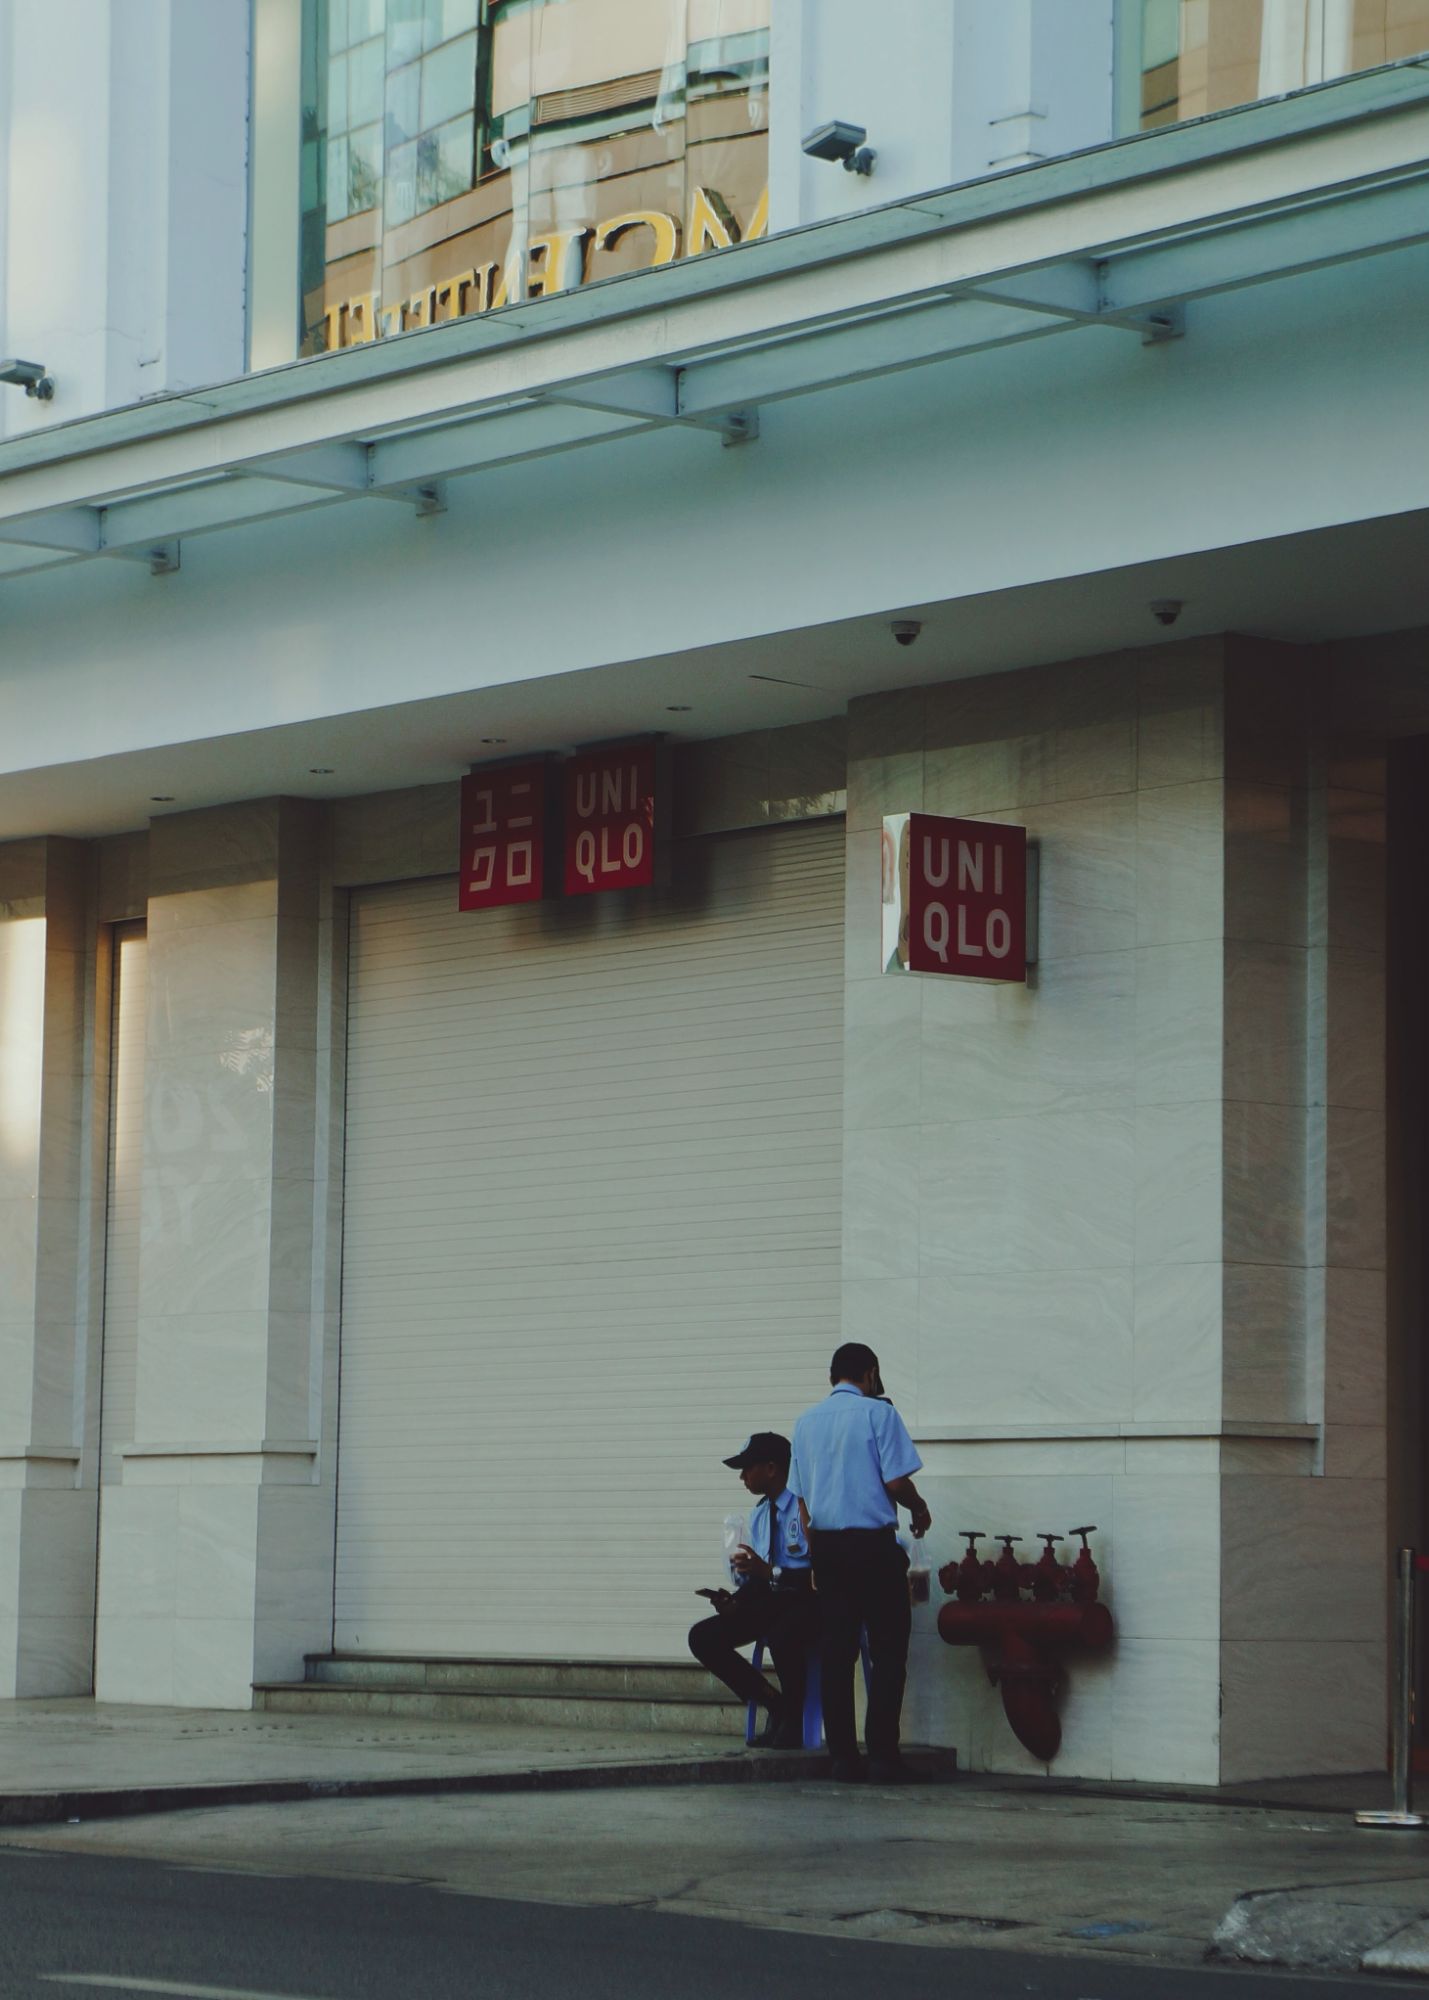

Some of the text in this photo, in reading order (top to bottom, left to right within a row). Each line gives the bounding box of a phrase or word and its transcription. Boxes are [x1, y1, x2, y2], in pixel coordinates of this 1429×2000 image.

[472, 783, 533, 835] ユニ
[576, 765, 638, 818] UNI
[469, 839, 533, 893] クロ
[575, 822, 644, 884] QLO
[923, 835, 1003, 895] UNI
[923, 901, 1011, 964] QLO
